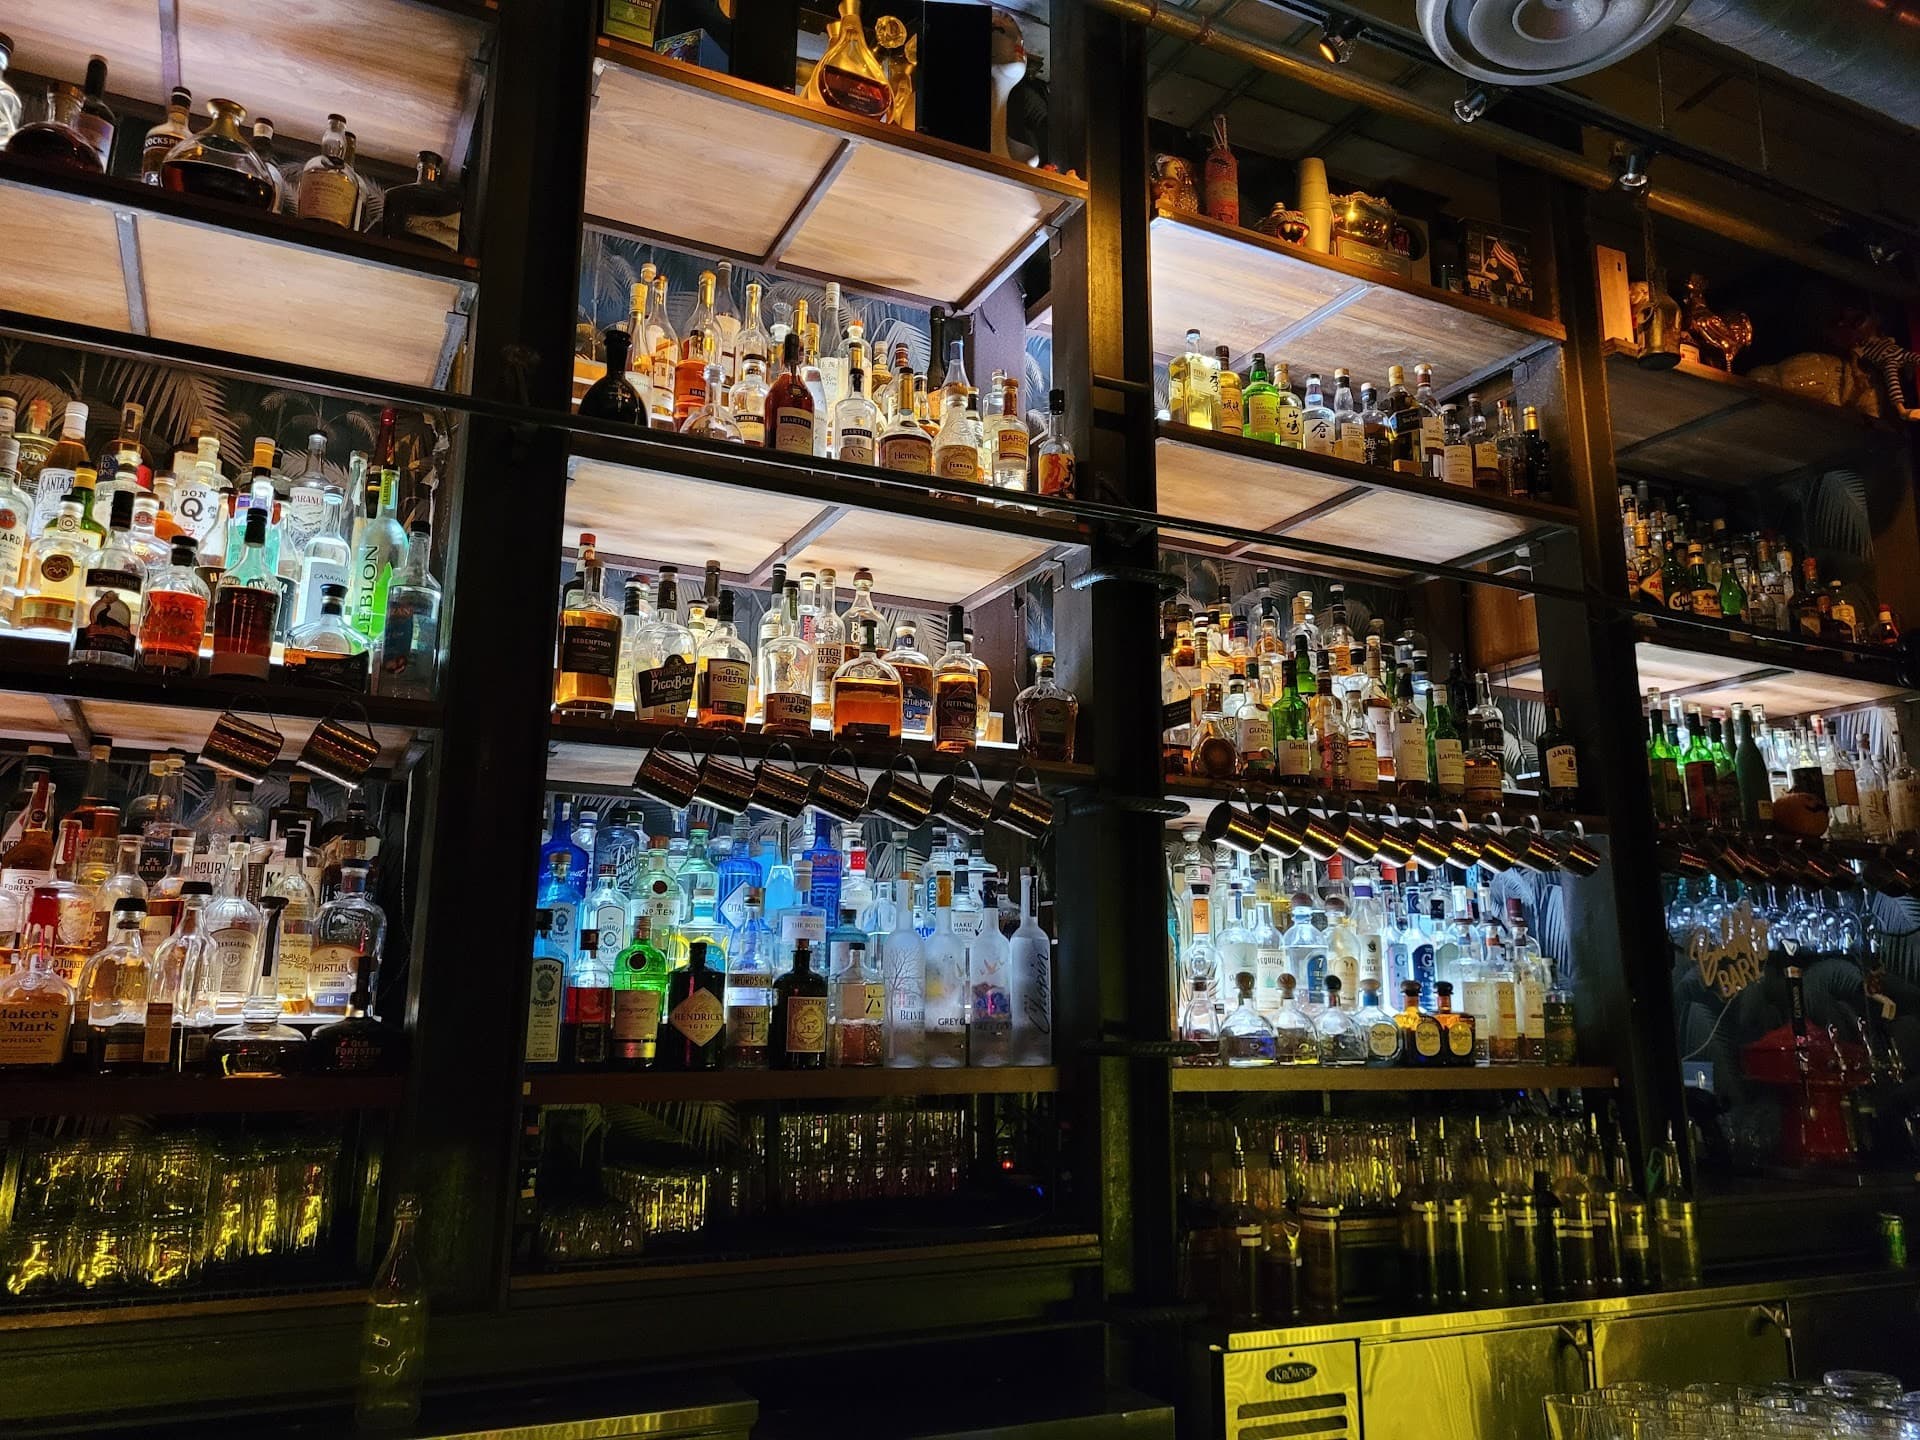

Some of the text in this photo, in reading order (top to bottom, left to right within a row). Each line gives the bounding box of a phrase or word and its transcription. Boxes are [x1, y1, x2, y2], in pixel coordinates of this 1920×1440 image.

[1002, 433, 1028, 445] BARSO
[181, 489, 207, 498] DON
[817, 647, 842, 657] HIGH
[817, 656, 842, 665] WEST
[725, 668, 740, 677] OLD
[712, 673, 747, 684] FORESTER
[4, 883, 36, 892] FOREST
[8, 1021, 57, 1032] Mark
[938, 1018, 960, 1026] GREY
[1273, 1368, 1313, 1382] KROWNE
